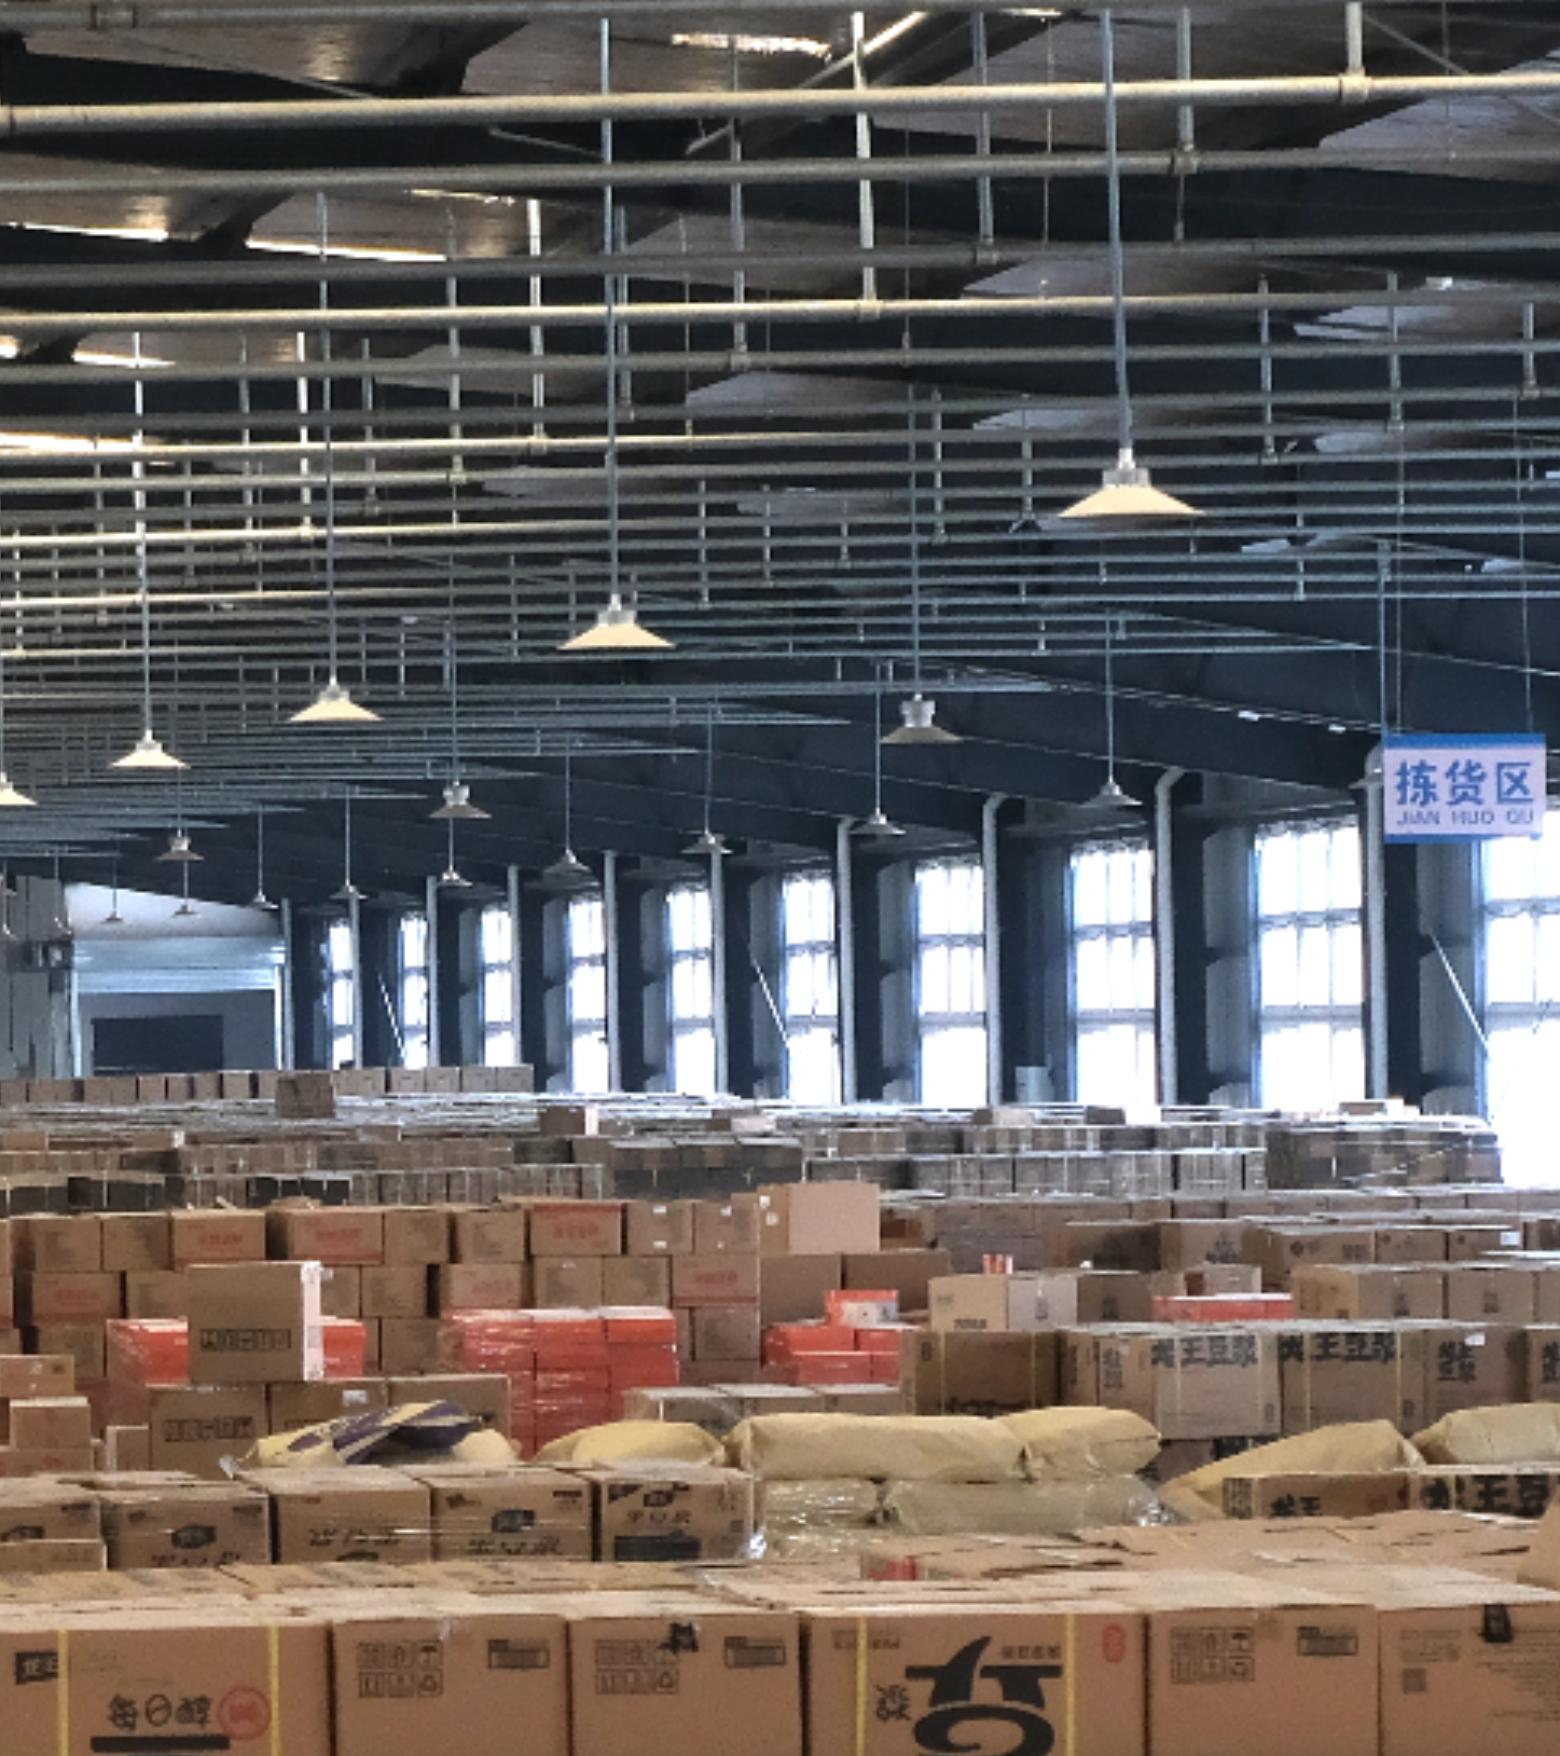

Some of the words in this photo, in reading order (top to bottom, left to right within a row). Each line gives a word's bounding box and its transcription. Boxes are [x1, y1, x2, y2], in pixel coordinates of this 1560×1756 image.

[1396, 759, 1534, 806] 拣货区
[1397, 810, 1440, 825] JIAN
[1451, 810, 1494, 825] HUO
[1506, 808, 1533, 824] QU
[106, 1695, 212, 1729] 每日醇
